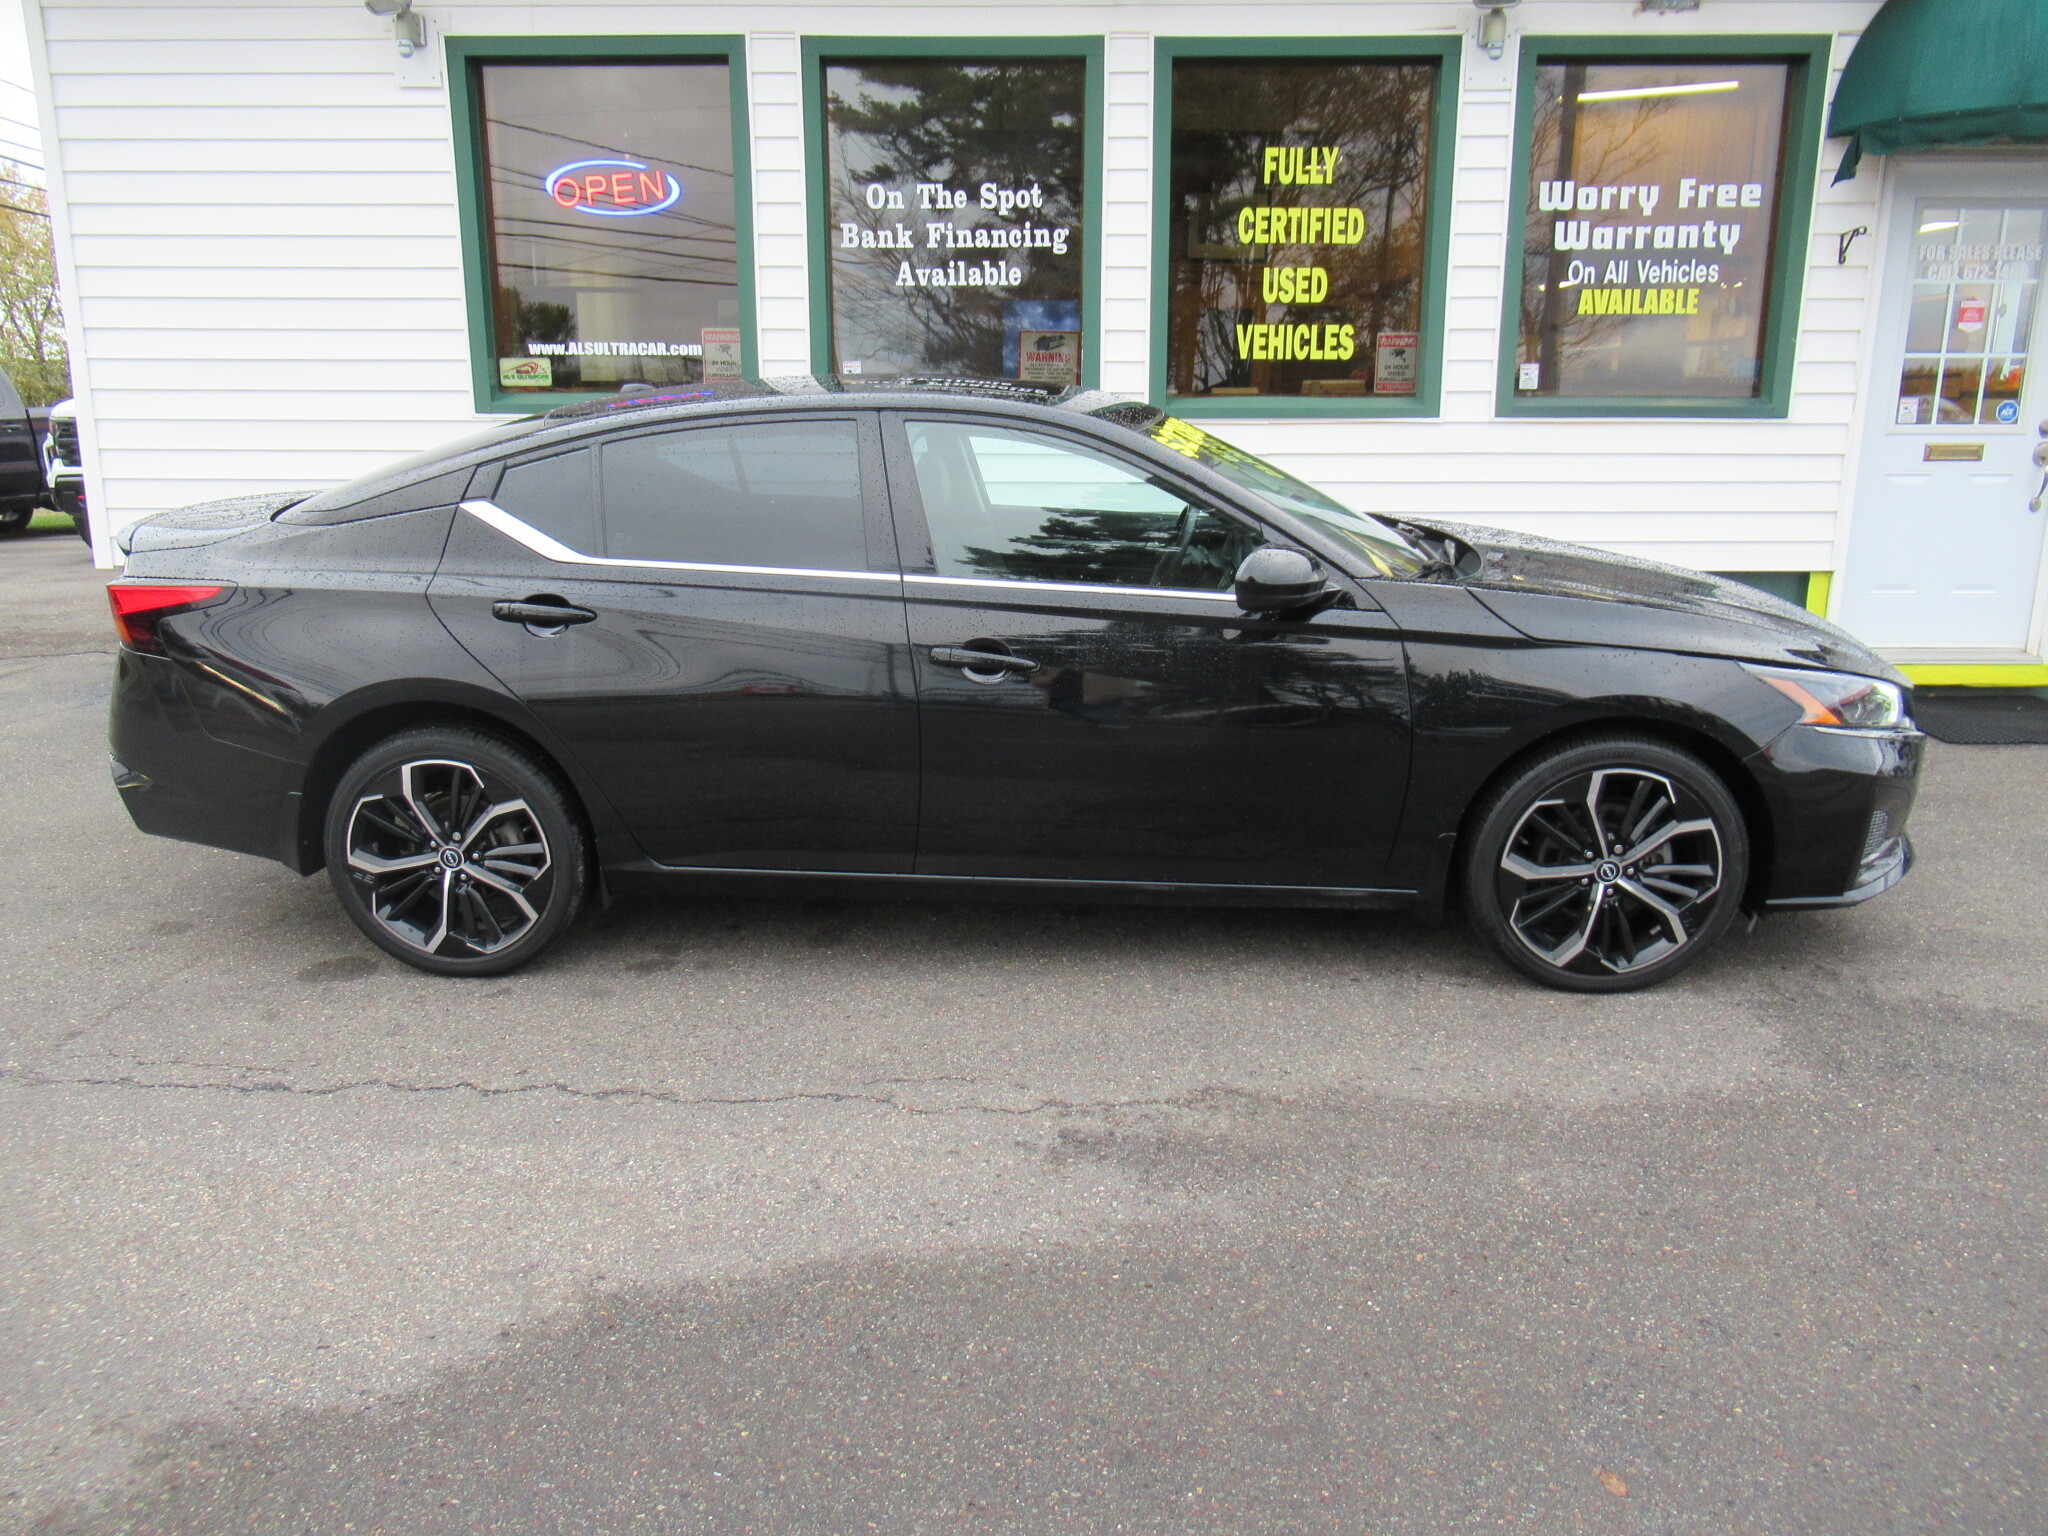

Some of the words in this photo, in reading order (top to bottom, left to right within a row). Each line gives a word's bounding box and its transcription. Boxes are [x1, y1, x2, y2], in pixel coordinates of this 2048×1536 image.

[1263, 146, 1340, 185] FULLY
[553, 169, 666, 209] OPEN
[866, 182, 905, 210] On
[916, 182, 968, 210] The
[979, 181, 1043, 216] Spot
[1538, 180, 1660, 216] Worry
[1677, 177, 1763, 209] Free
[839, 222, 914, 249] Bank
[926, 220, 1070, 255] Financing
[1237, 206, 1366, 245] CERTIFIED
[1553, 219, 1741, 255] Warranty
[1919, 245, 1946, 260] FOR
[1948, 245, 1990, 260] SALES
[1993, 244, 2043, 260] PLEASE
[895, 260, 1023, 287] Available
[1262, 266, 1329, 304] USED
[1567, 259, 1596, 285] On
[1603, 259, 1629, 284] All
[1637, 258, 1720, 284] Vehicles
[1577, 287, 1701, 315] AVAILABLE
[528, 341, 703, 357] www.ALSULTRACAR.com
[1026, 352, 1071, 363] WARNING
[1236, 323, 1356, 361] VEHICLES
